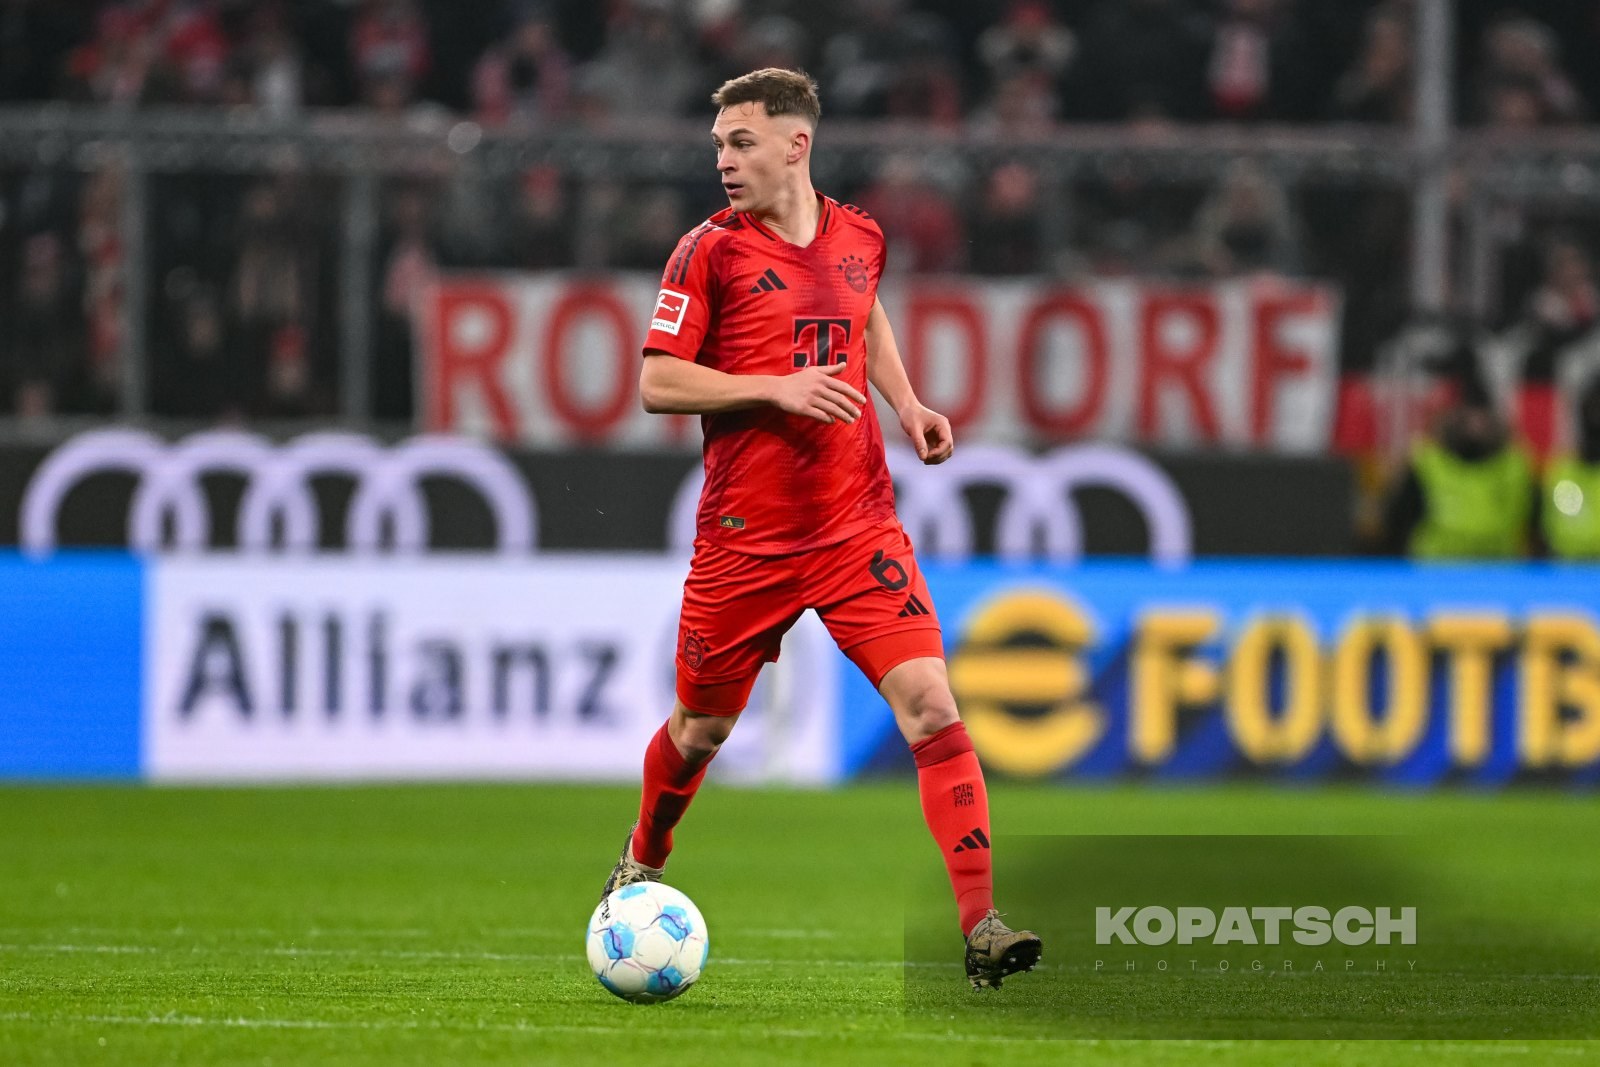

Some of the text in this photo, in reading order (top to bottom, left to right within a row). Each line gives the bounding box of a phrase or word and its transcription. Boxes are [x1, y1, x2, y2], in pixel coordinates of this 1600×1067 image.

[438, 278, 1320, 440] RODORF
[794, 319, 851, 367] T
[868, 549, 908, 591] 6
[179, 606, 624, 722] Allianz
[953, 783, 973, 793] MIA
[953, 791, 973, 799] SAN
[954, 798, 975, 808] MIA
